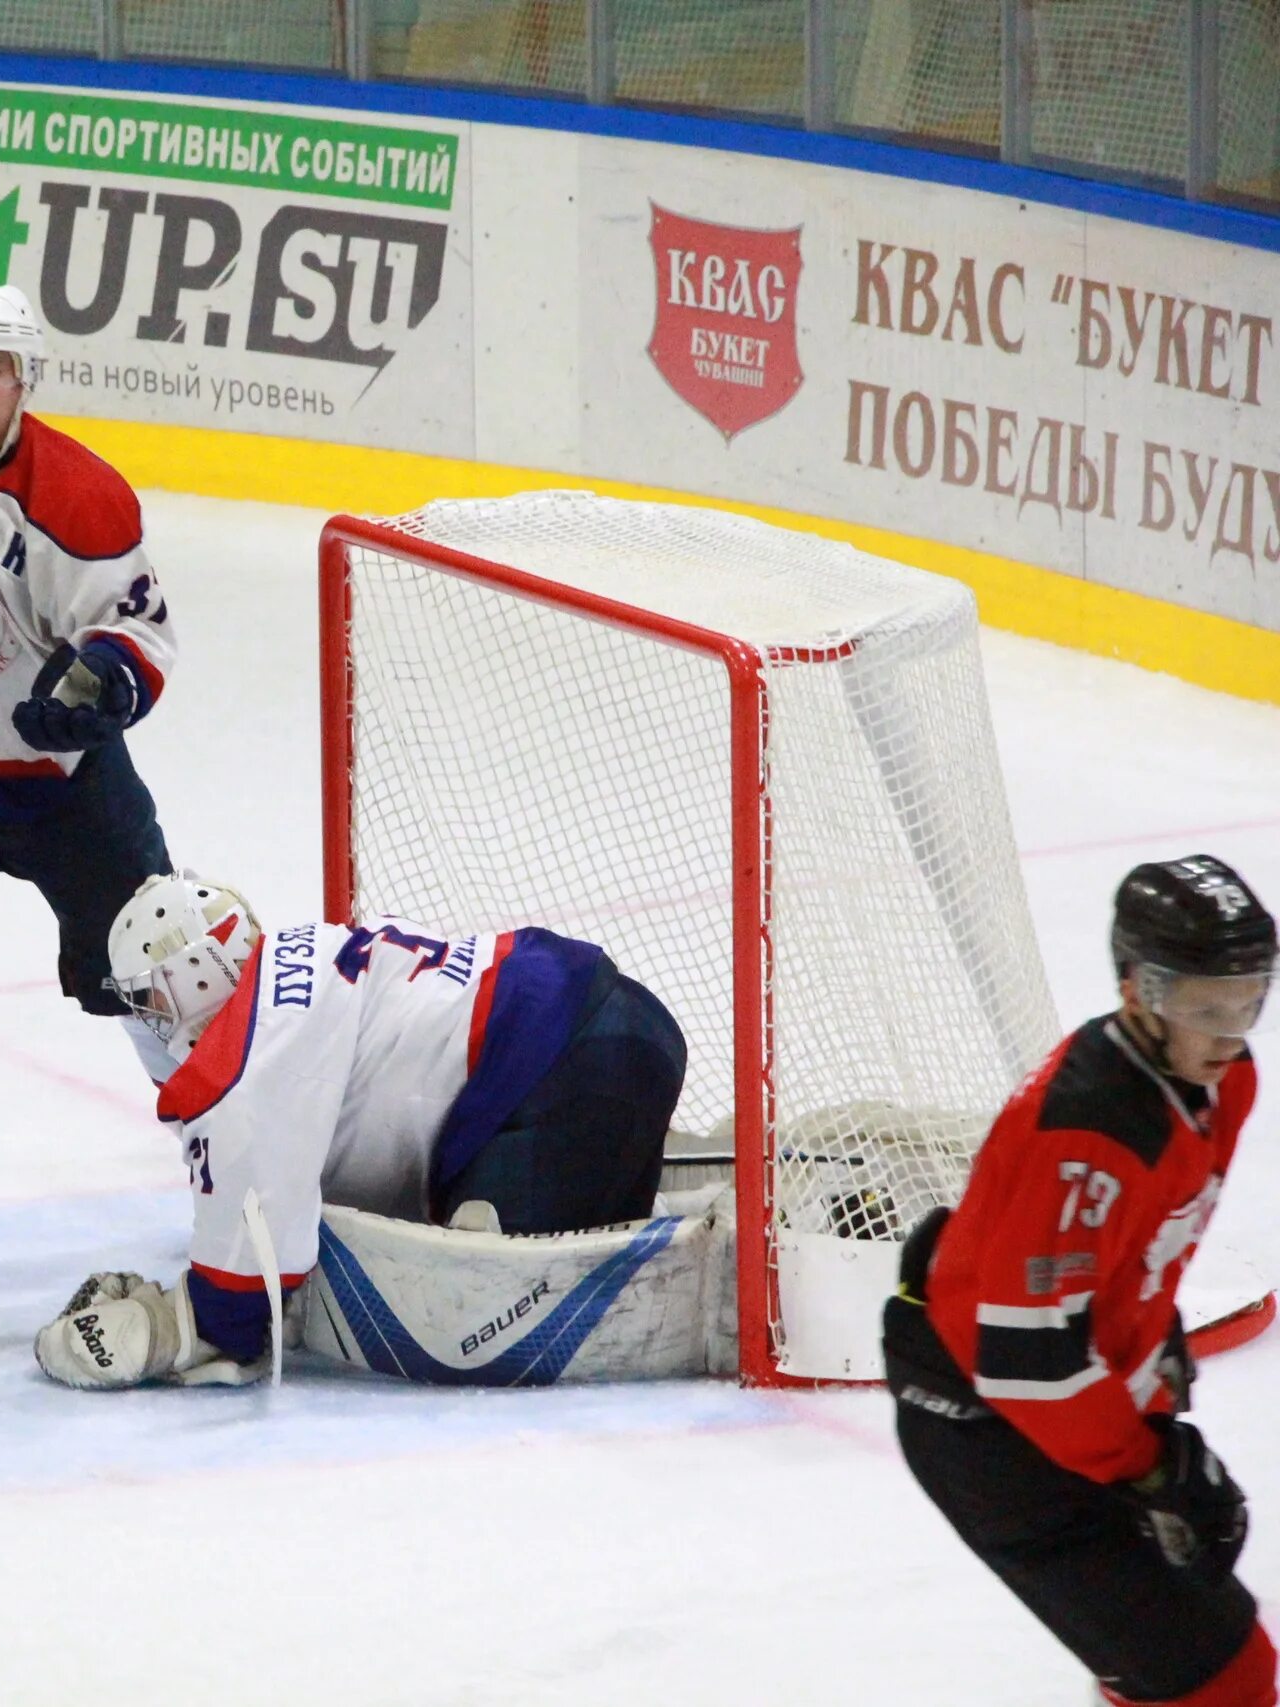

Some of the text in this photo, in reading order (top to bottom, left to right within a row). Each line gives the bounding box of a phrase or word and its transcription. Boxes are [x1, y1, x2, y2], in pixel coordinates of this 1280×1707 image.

[44, 112, 282, 175] СПОРТИВНЫХ
[290, 138, 451, 196] СОБЫТИЙ
[667, 249, 785, 323] КВАС
[852, 239, 1026, 354] КВАС
[691, 328, 769, 368] БУКЕТ
[694, 359, 765, 388] ЧУВАШИИ
[59, 360, 93, 386] на
[104, 362, 200, 398] новый
[211, 376, 335, 416] уровень
[844, 379, 1118, 530] ПОБЕДЫ
[461, 1281, 550, 1356] BAUER
